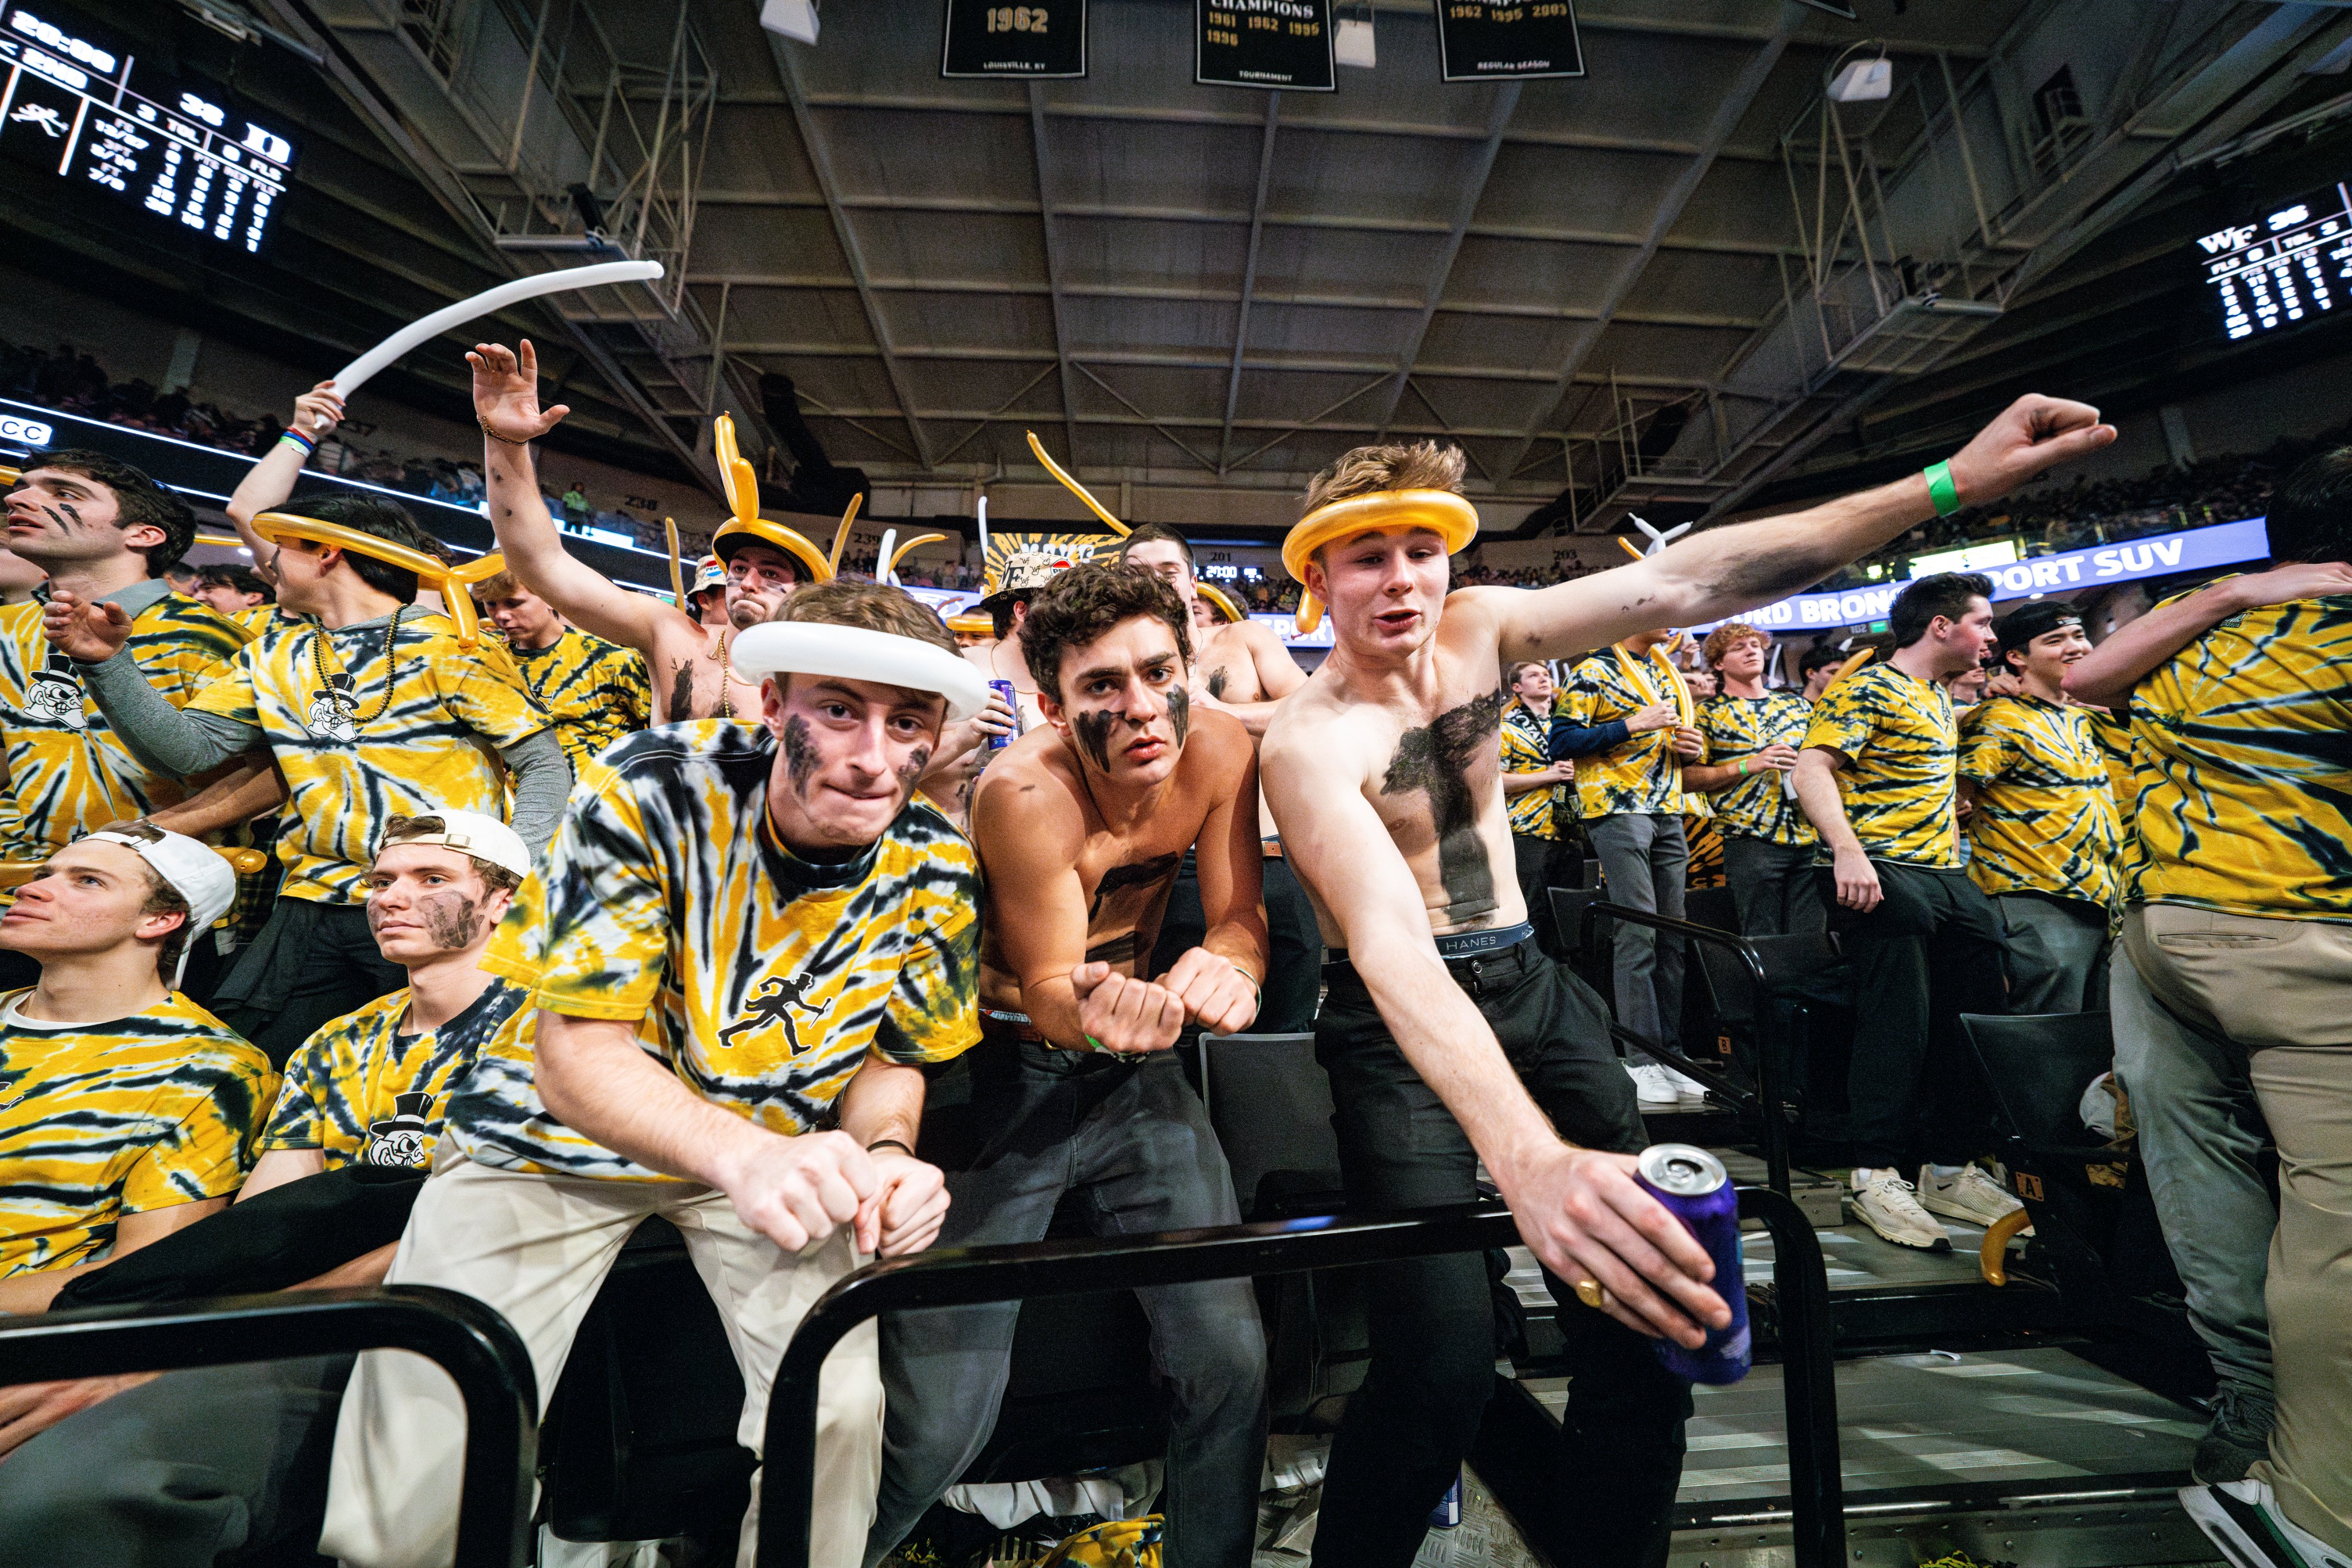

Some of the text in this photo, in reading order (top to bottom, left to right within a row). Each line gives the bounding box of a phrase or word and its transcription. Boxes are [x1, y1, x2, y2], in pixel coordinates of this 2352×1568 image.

[987, 6, 1049, 33] 1962
[11, 10, 117, 73] 20:00
[22, 48, 88, 89] 2ND
[1239, 71, 1293, 82] TOURNAMENT
[1517, 60, 1550, 70] SEASON
[167, 118, 200, 144] TOL
[250, 158, 282, 181] FLS
[2196, 223, 2257, 254] WF
[2211, 257, 2240, 275] FLS
[1211, 552, 1231, 562] 201
[2093, 539, 2183, 576] SUV
[1446, 936, 1496, 951] HANES
[2025, 1177, 2036, 1197] A
